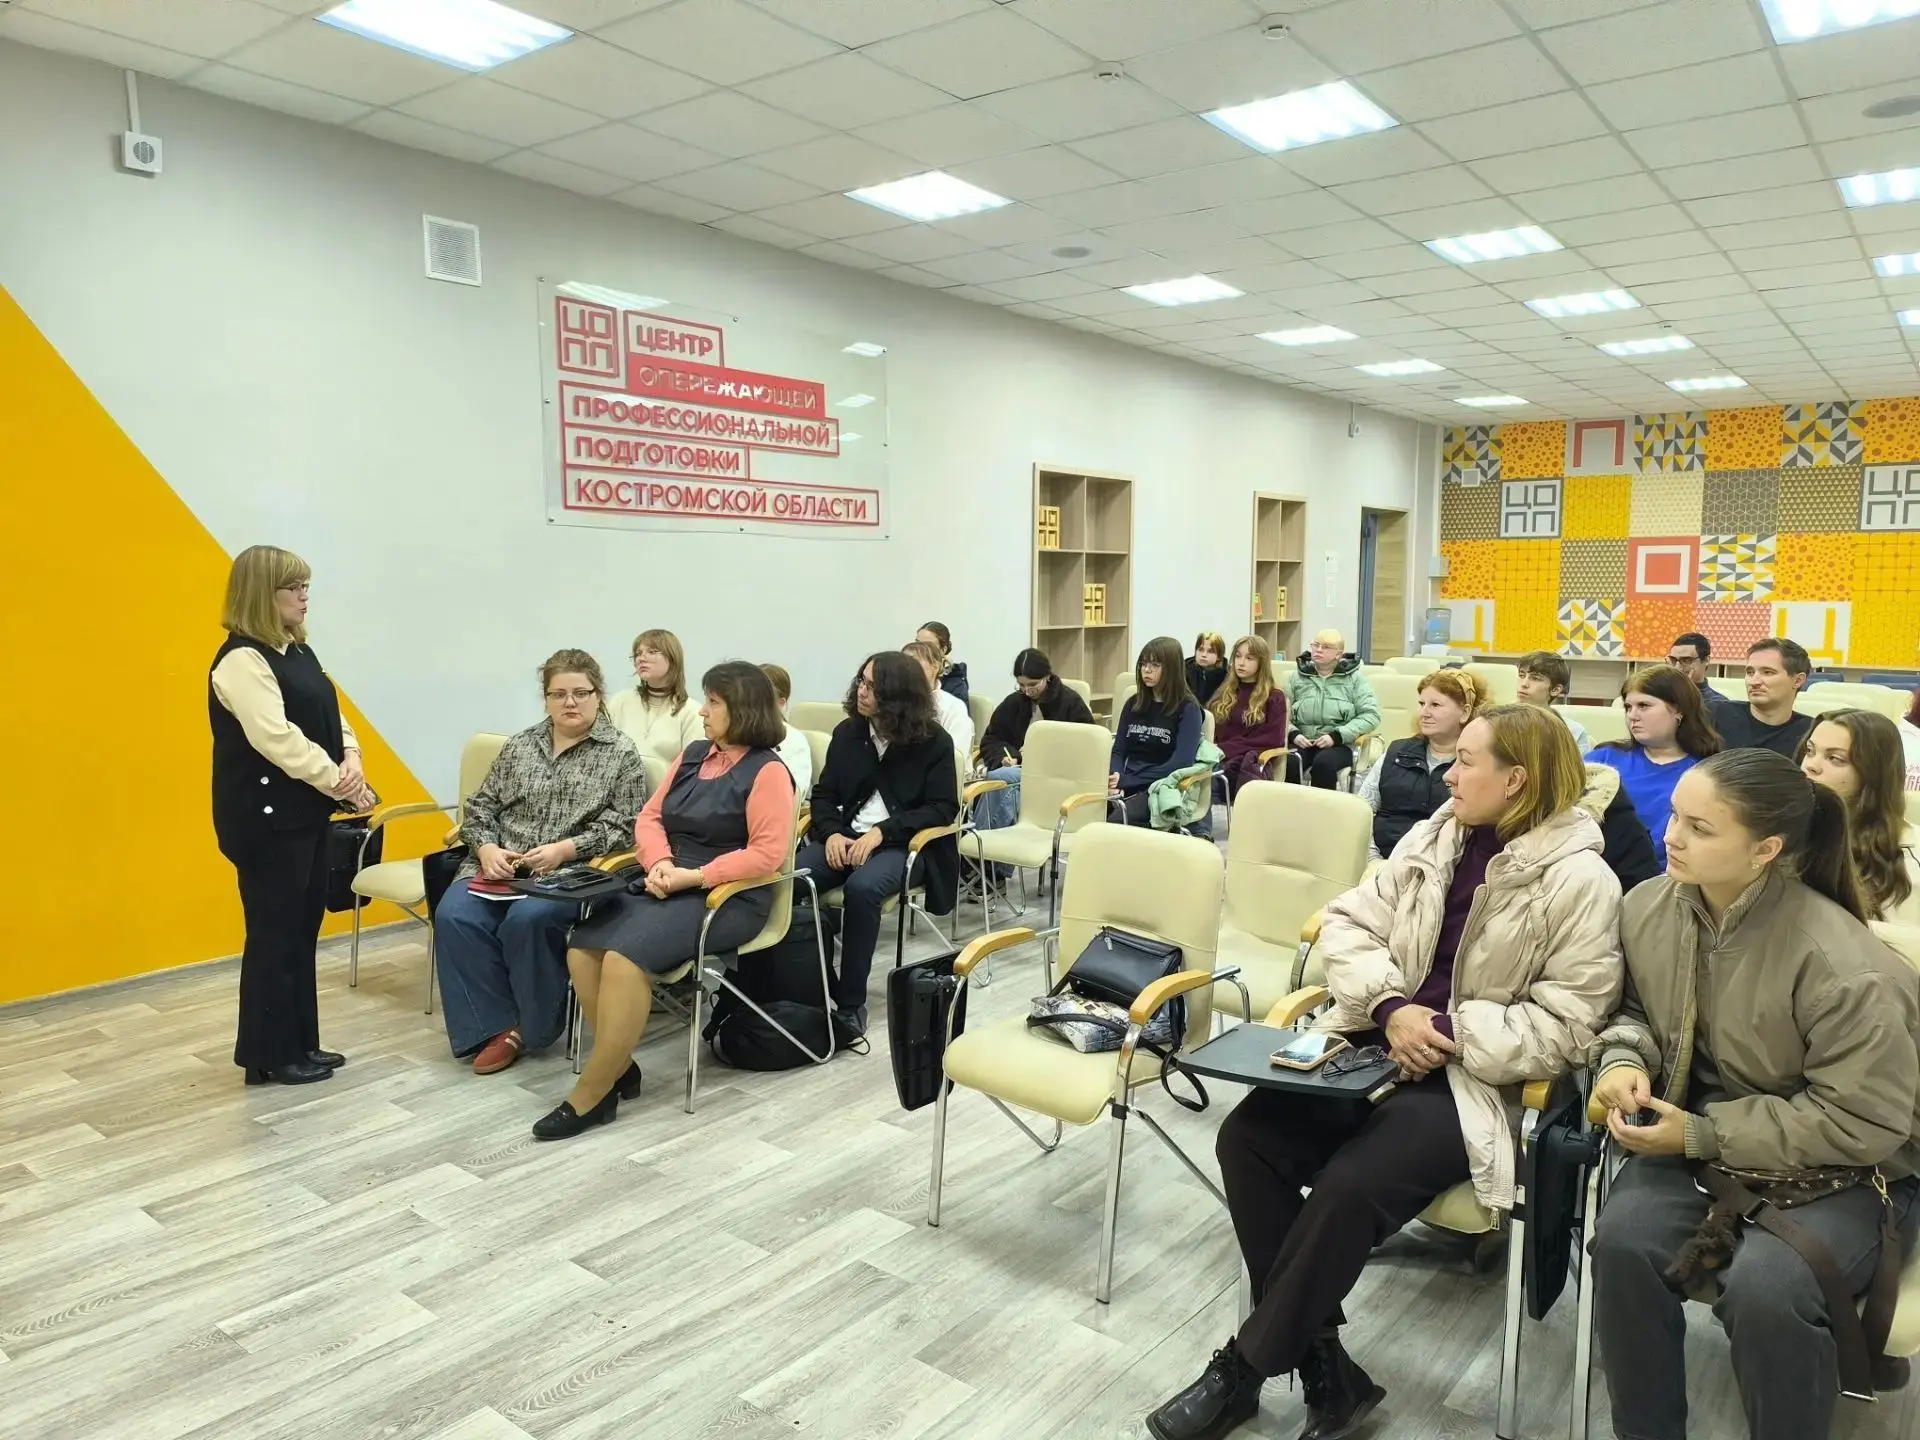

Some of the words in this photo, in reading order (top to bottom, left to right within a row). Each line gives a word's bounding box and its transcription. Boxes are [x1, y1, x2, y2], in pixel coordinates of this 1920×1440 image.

[636, 324, 713, 356] ЦЕНТР
[639, 366, 816, 411] ОПЕРЕЖАЮЩЕЙ
[573, 394, 830, 448] ПРОФЕССИОНАЛЬНОЙ
[574, 435, 739, 472] ПОДГОТОВКИ
[575, 477, 767, 515] КОСТРОМСКОЙ
[772, 491, 868, 520] ОБЛАСТИ
